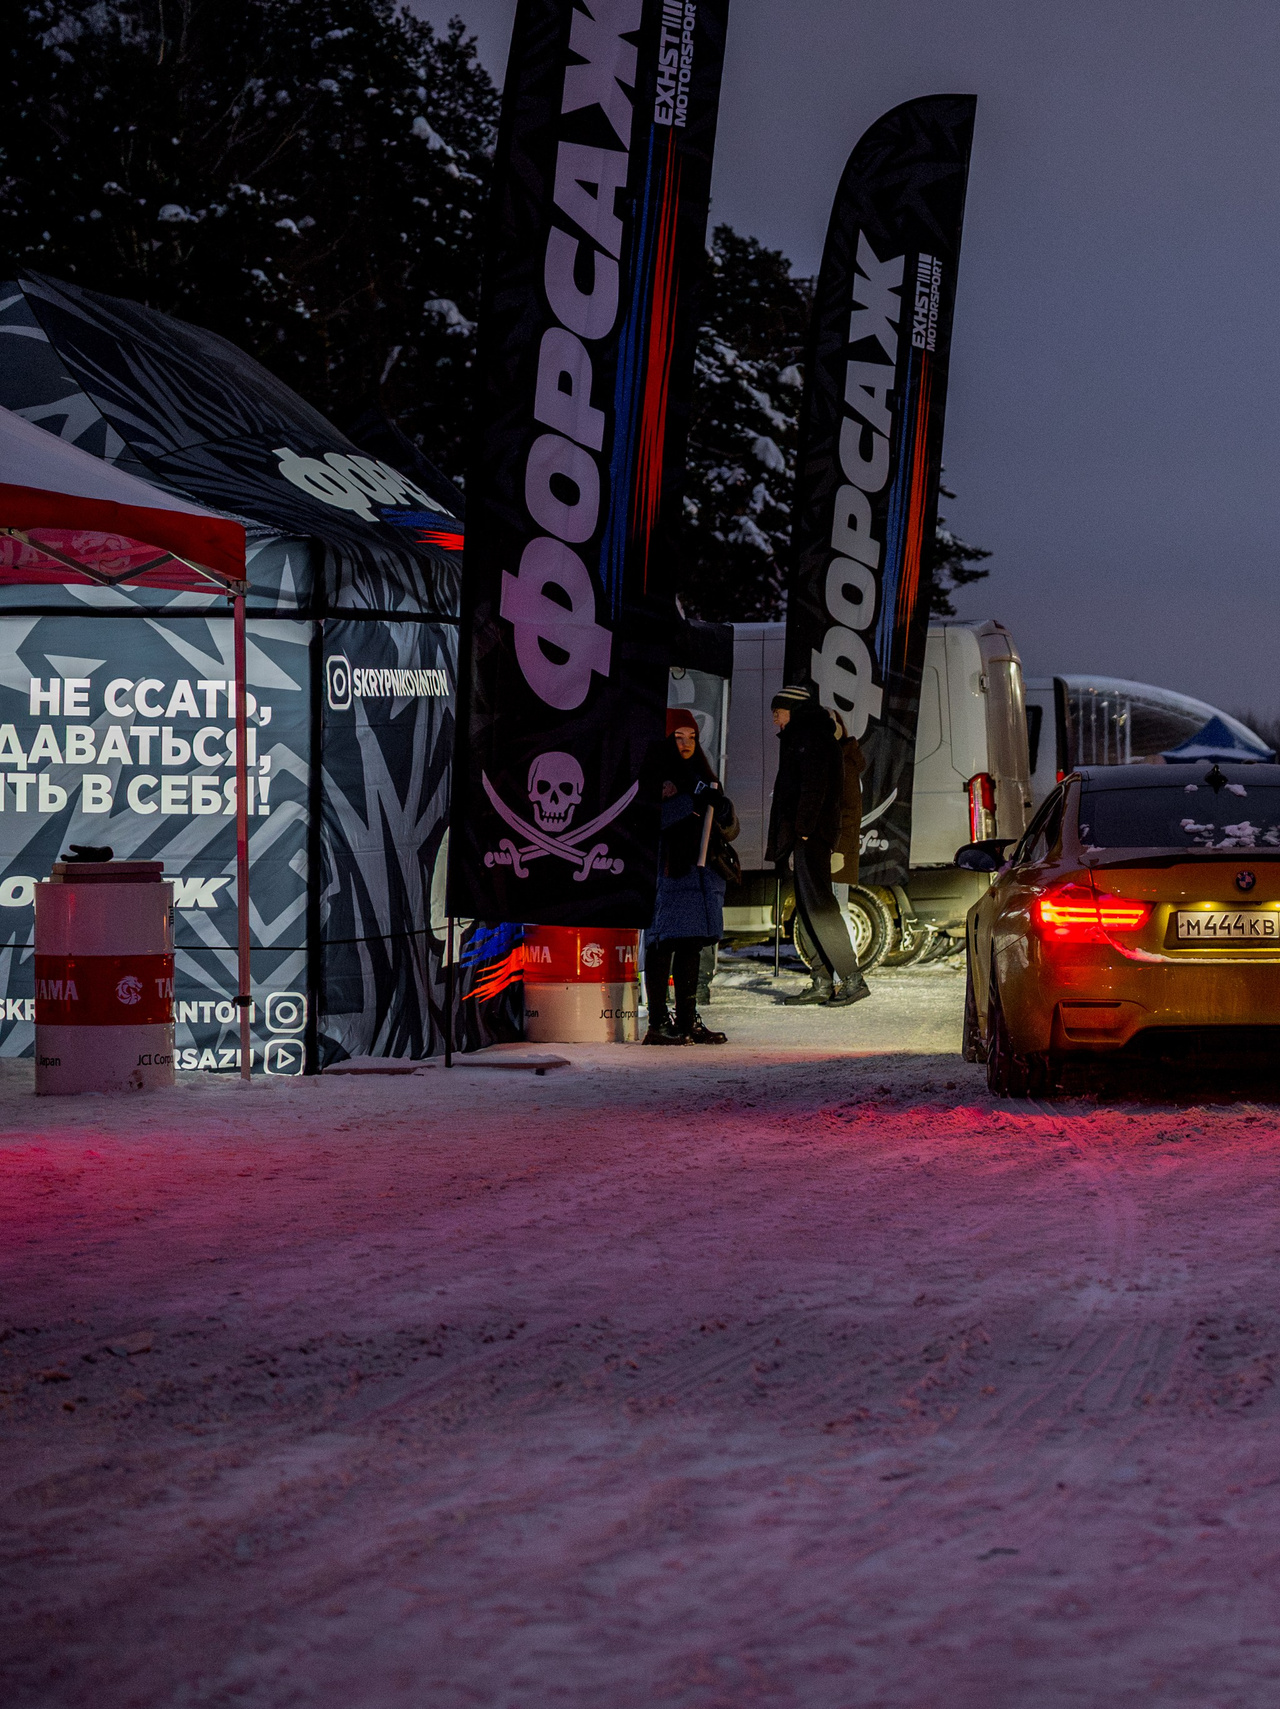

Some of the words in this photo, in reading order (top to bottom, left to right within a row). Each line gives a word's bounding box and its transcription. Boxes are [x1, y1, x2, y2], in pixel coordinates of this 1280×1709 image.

[674, 0, 697, 127] MOTORSPOR
[926, 257, 943, 352] MOTORSPORT
[811, 229, 905, 741] ФОРСАЖ
[29, 678, 91, 716] НЕ
[104, 678, 272, 727] ССАТЬ,
[0, 724, 272, 775] ДАВАТЬСЯ,
[0, 772, 69, 813] ТЬ
[82, 774, 114, 813] В
[127, 775, 270, 815] СЕБЯ!
[137, 1054, 152, 1066] JCI
